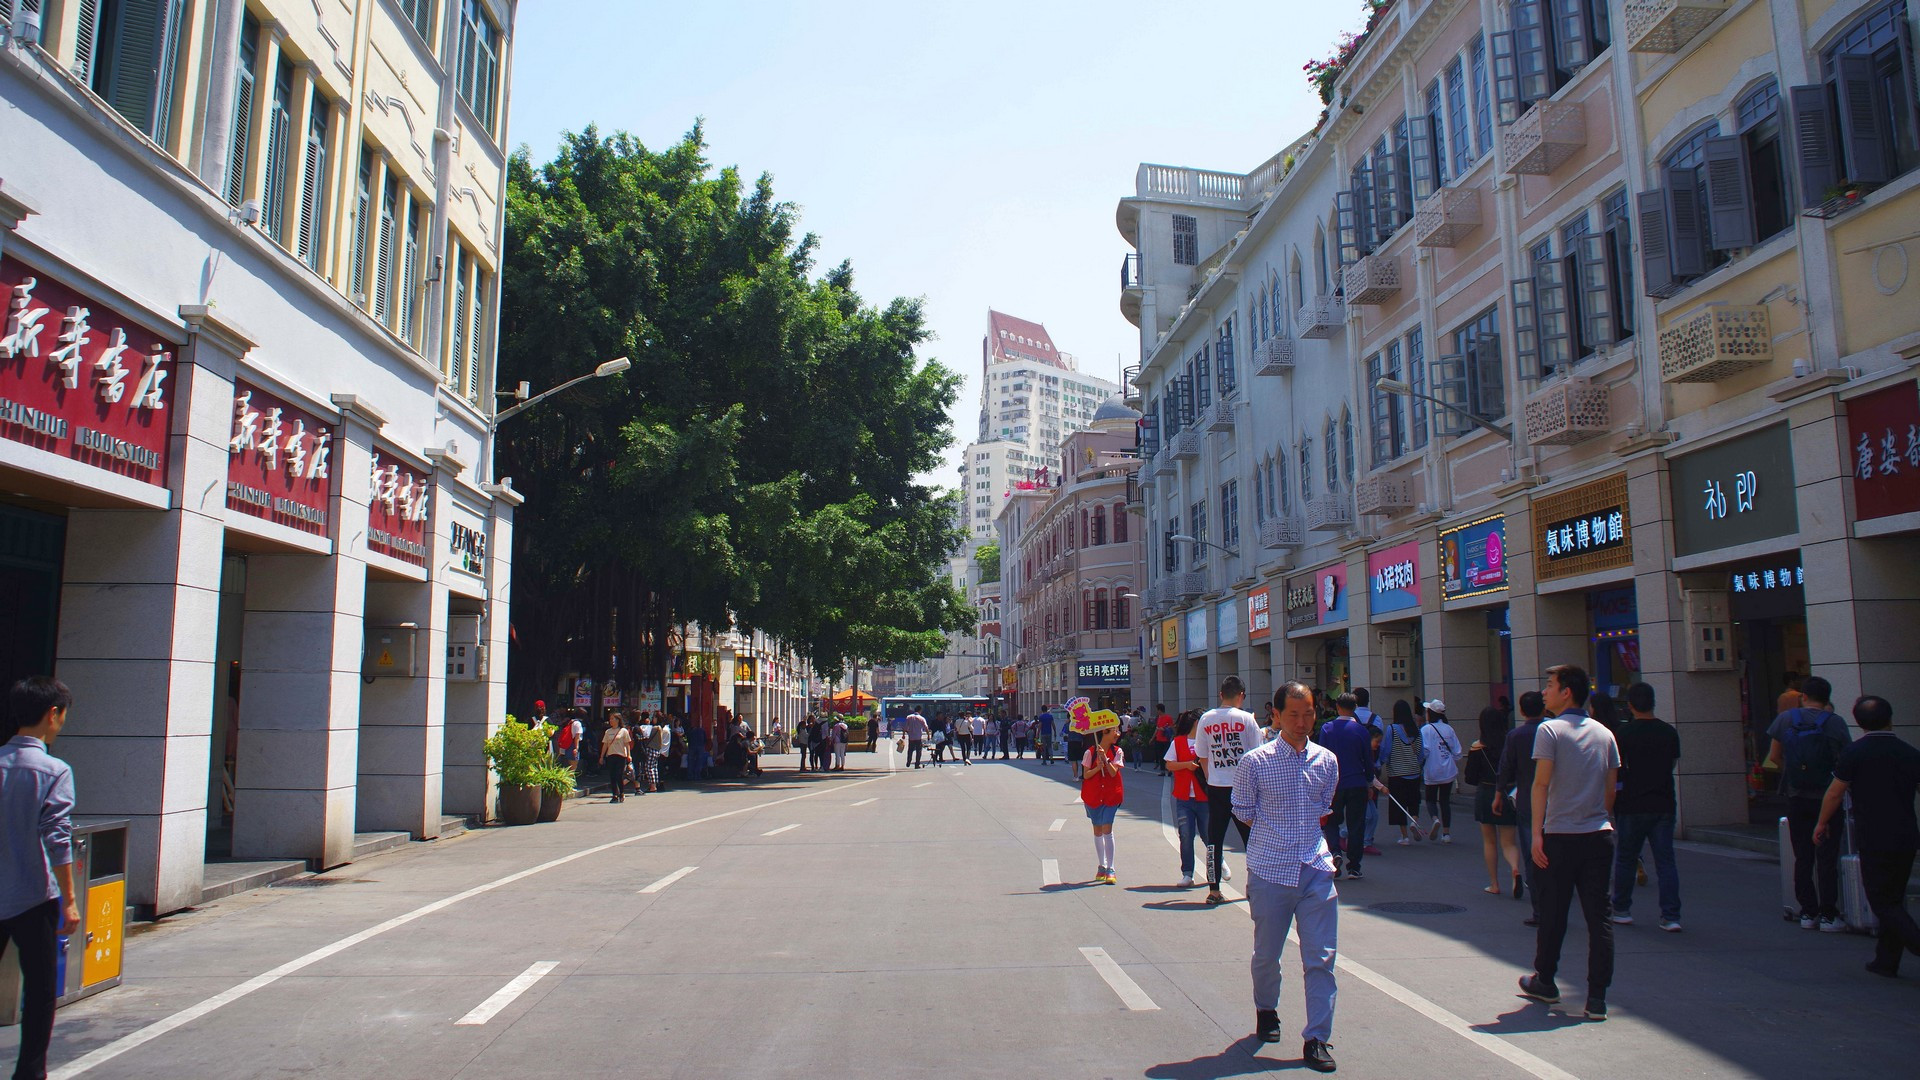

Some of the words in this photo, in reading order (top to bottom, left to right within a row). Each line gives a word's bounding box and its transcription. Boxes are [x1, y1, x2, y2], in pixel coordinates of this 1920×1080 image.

[0, 397, 69, 440] XINHUA
[76, 426, 161, 470] BOOKSTORE
[229, 481, 272, 508] XINHUA
[274, 496, 327, 526] BOOKSTORE
[1078, 664, 1129, 677] 宫廷月亮虾饼
[1204, 722, 1245, 736] WORLD
[1211, 747, 1244, 759] TOKYO
